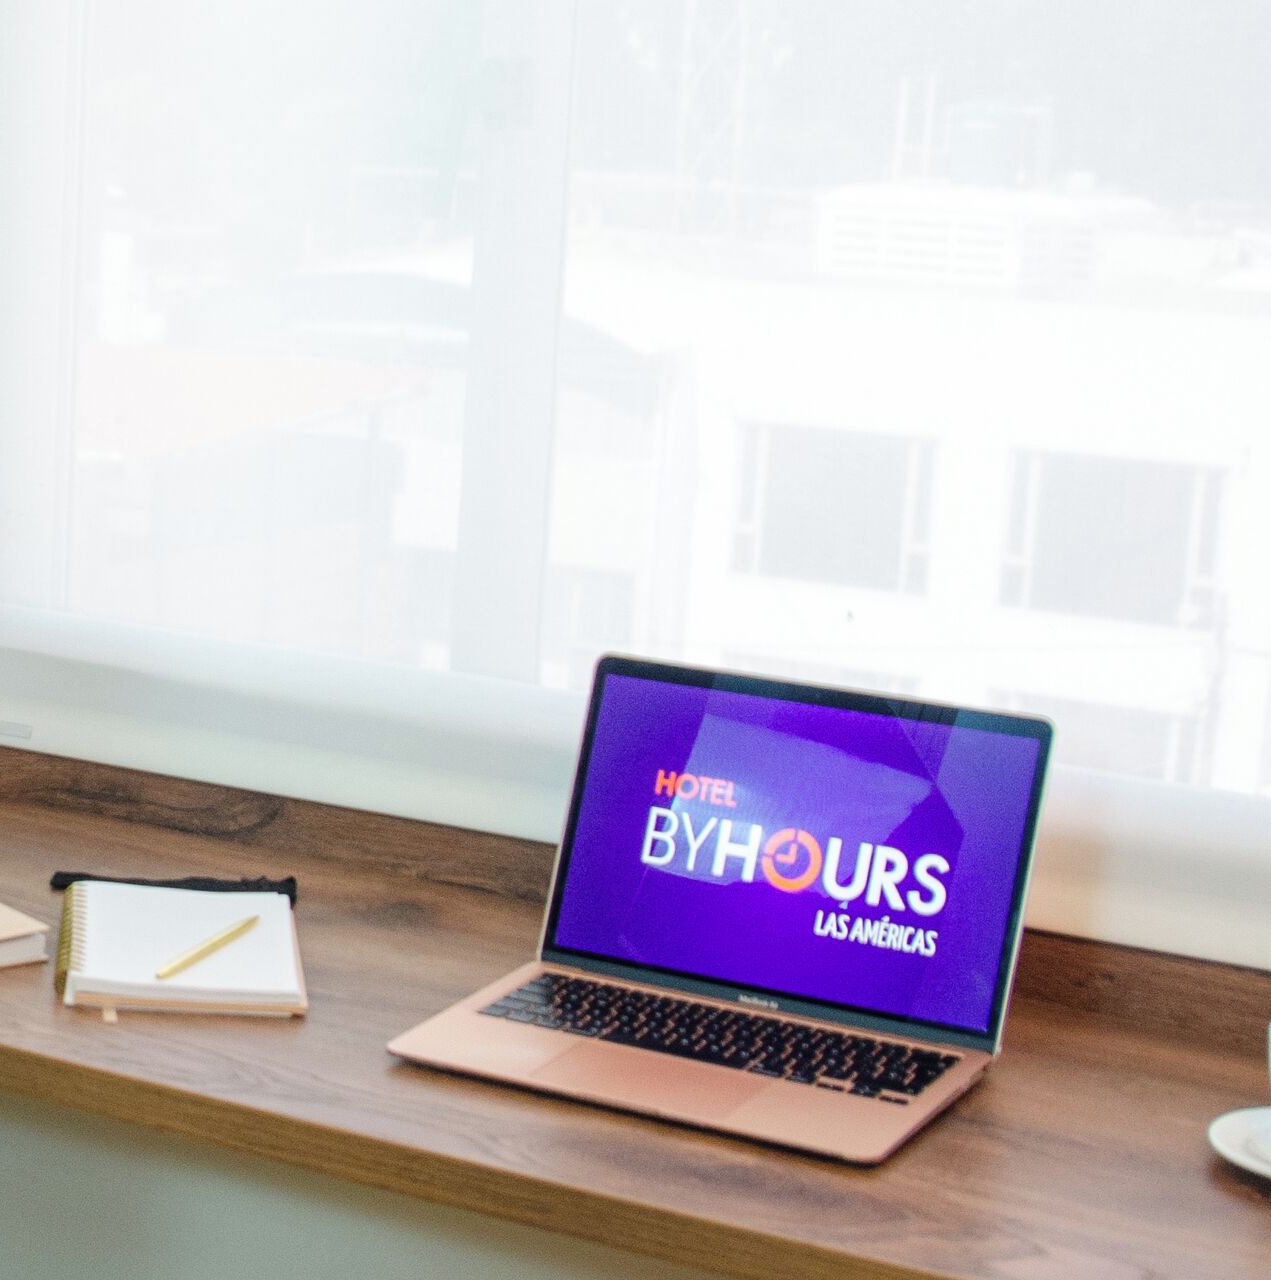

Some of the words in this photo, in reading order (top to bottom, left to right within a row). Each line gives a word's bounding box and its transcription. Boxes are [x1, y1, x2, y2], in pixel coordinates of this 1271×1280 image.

[654, 769, 737, 807] HOTEL
[640, 805, 950, 916] BYHOURS
[813, 909, 850, 940] LAS
[848, 915, 939, 957] AMÉRICAS
